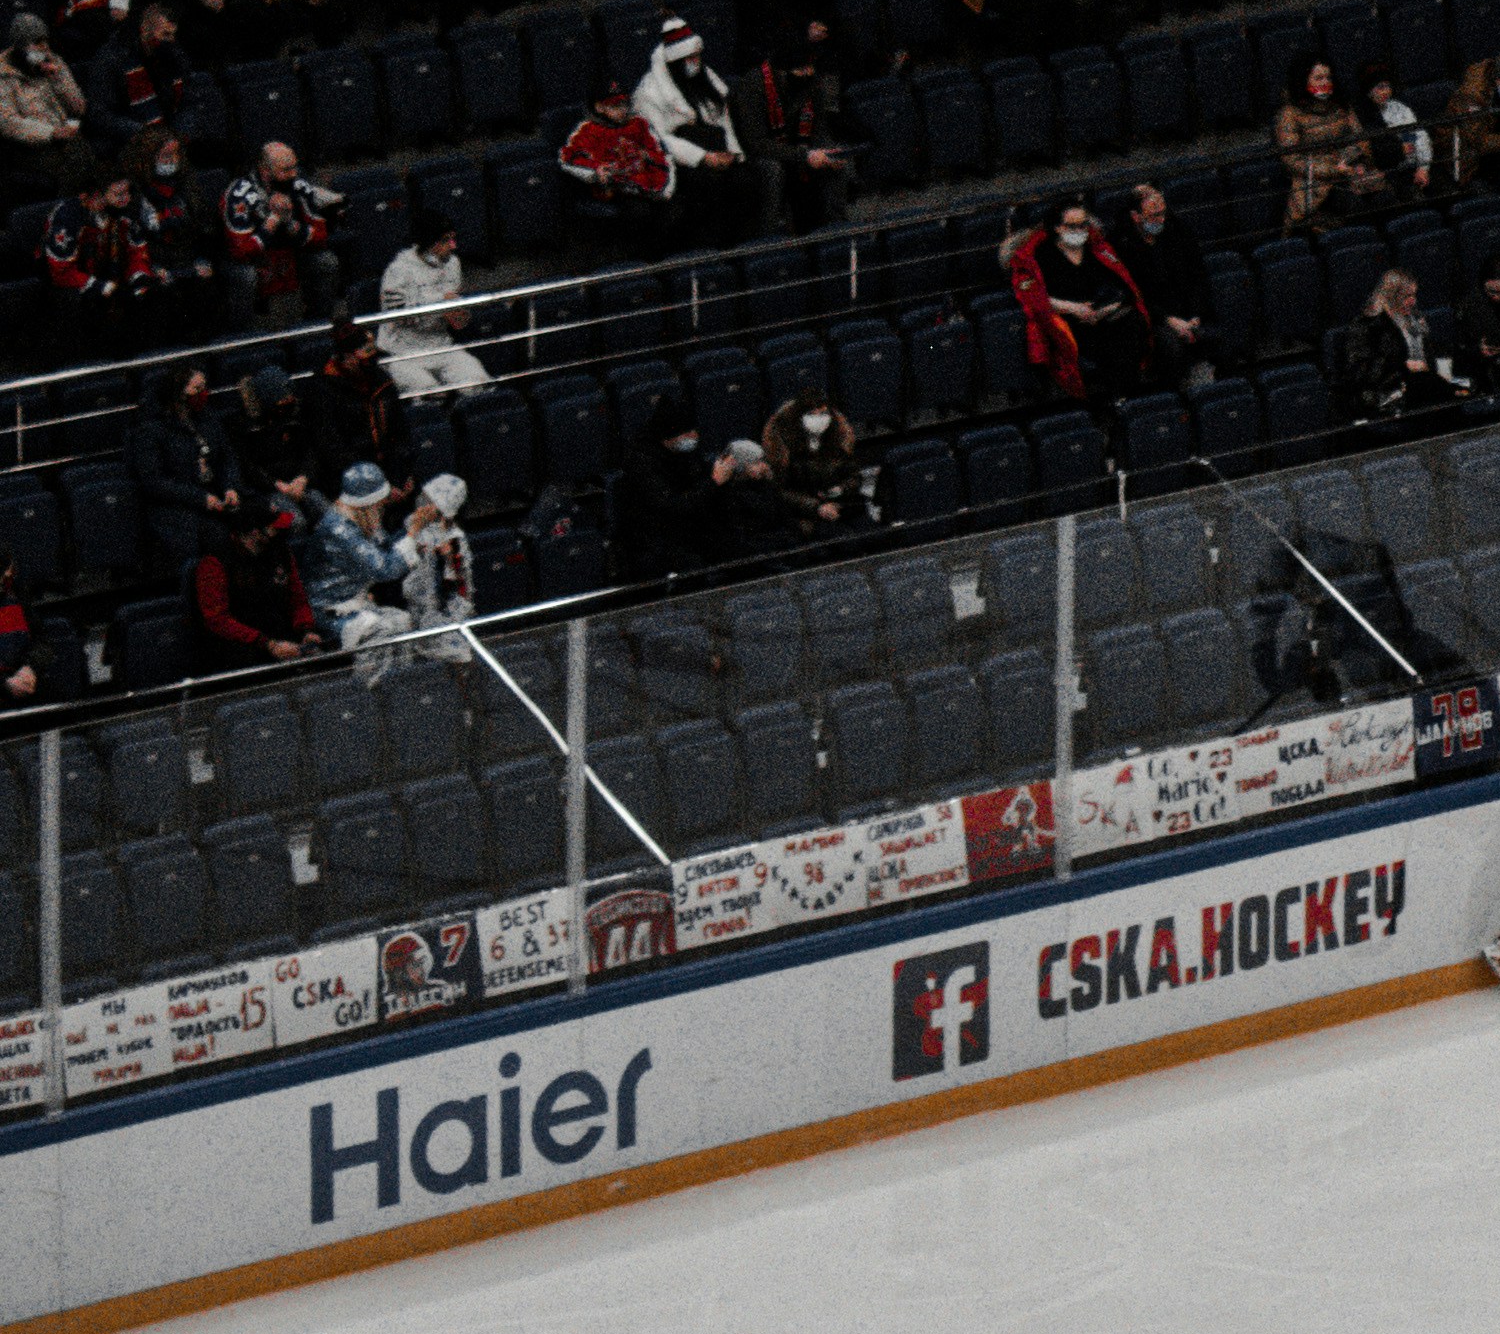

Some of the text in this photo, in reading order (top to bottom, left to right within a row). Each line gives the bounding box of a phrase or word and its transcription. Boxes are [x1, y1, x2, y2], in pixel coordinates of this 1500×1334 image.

[1431, 686, 1483, 758] 78
[499, 900, 547, 931] BEST
[440, 923, 470, 968] 7
[490, 935, 506, 961] 6
[1037, 858, 1408, 1020] CSKA.HOCKEY
[275, 957, 300, 983] GO
[240, 985, 268, 1032] 15
[334, 988, 371, 1028] GO!
[310, 1047, 653, 1226] Haier
